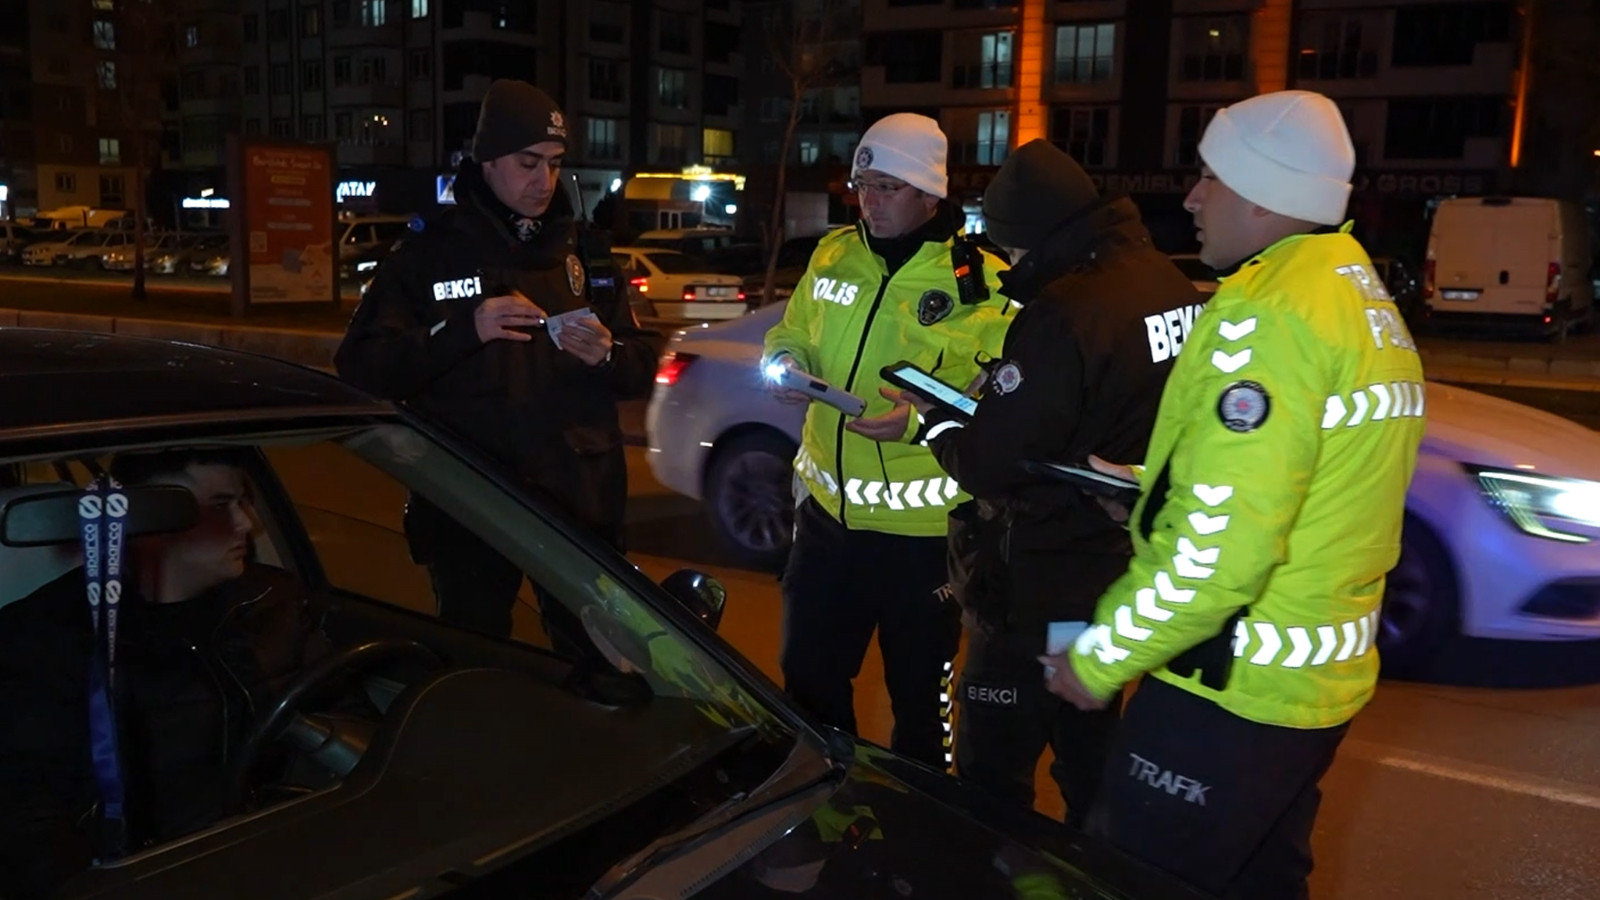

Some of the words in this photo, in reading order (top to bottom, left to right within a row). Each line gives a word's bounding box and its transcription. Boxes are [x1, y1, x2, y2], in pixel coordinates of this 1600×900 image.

[1376, 172, 1483, 193] GROSS
[812, 276, 859, 306] OLİS
[1144, 303, 1206, 363] BEK
